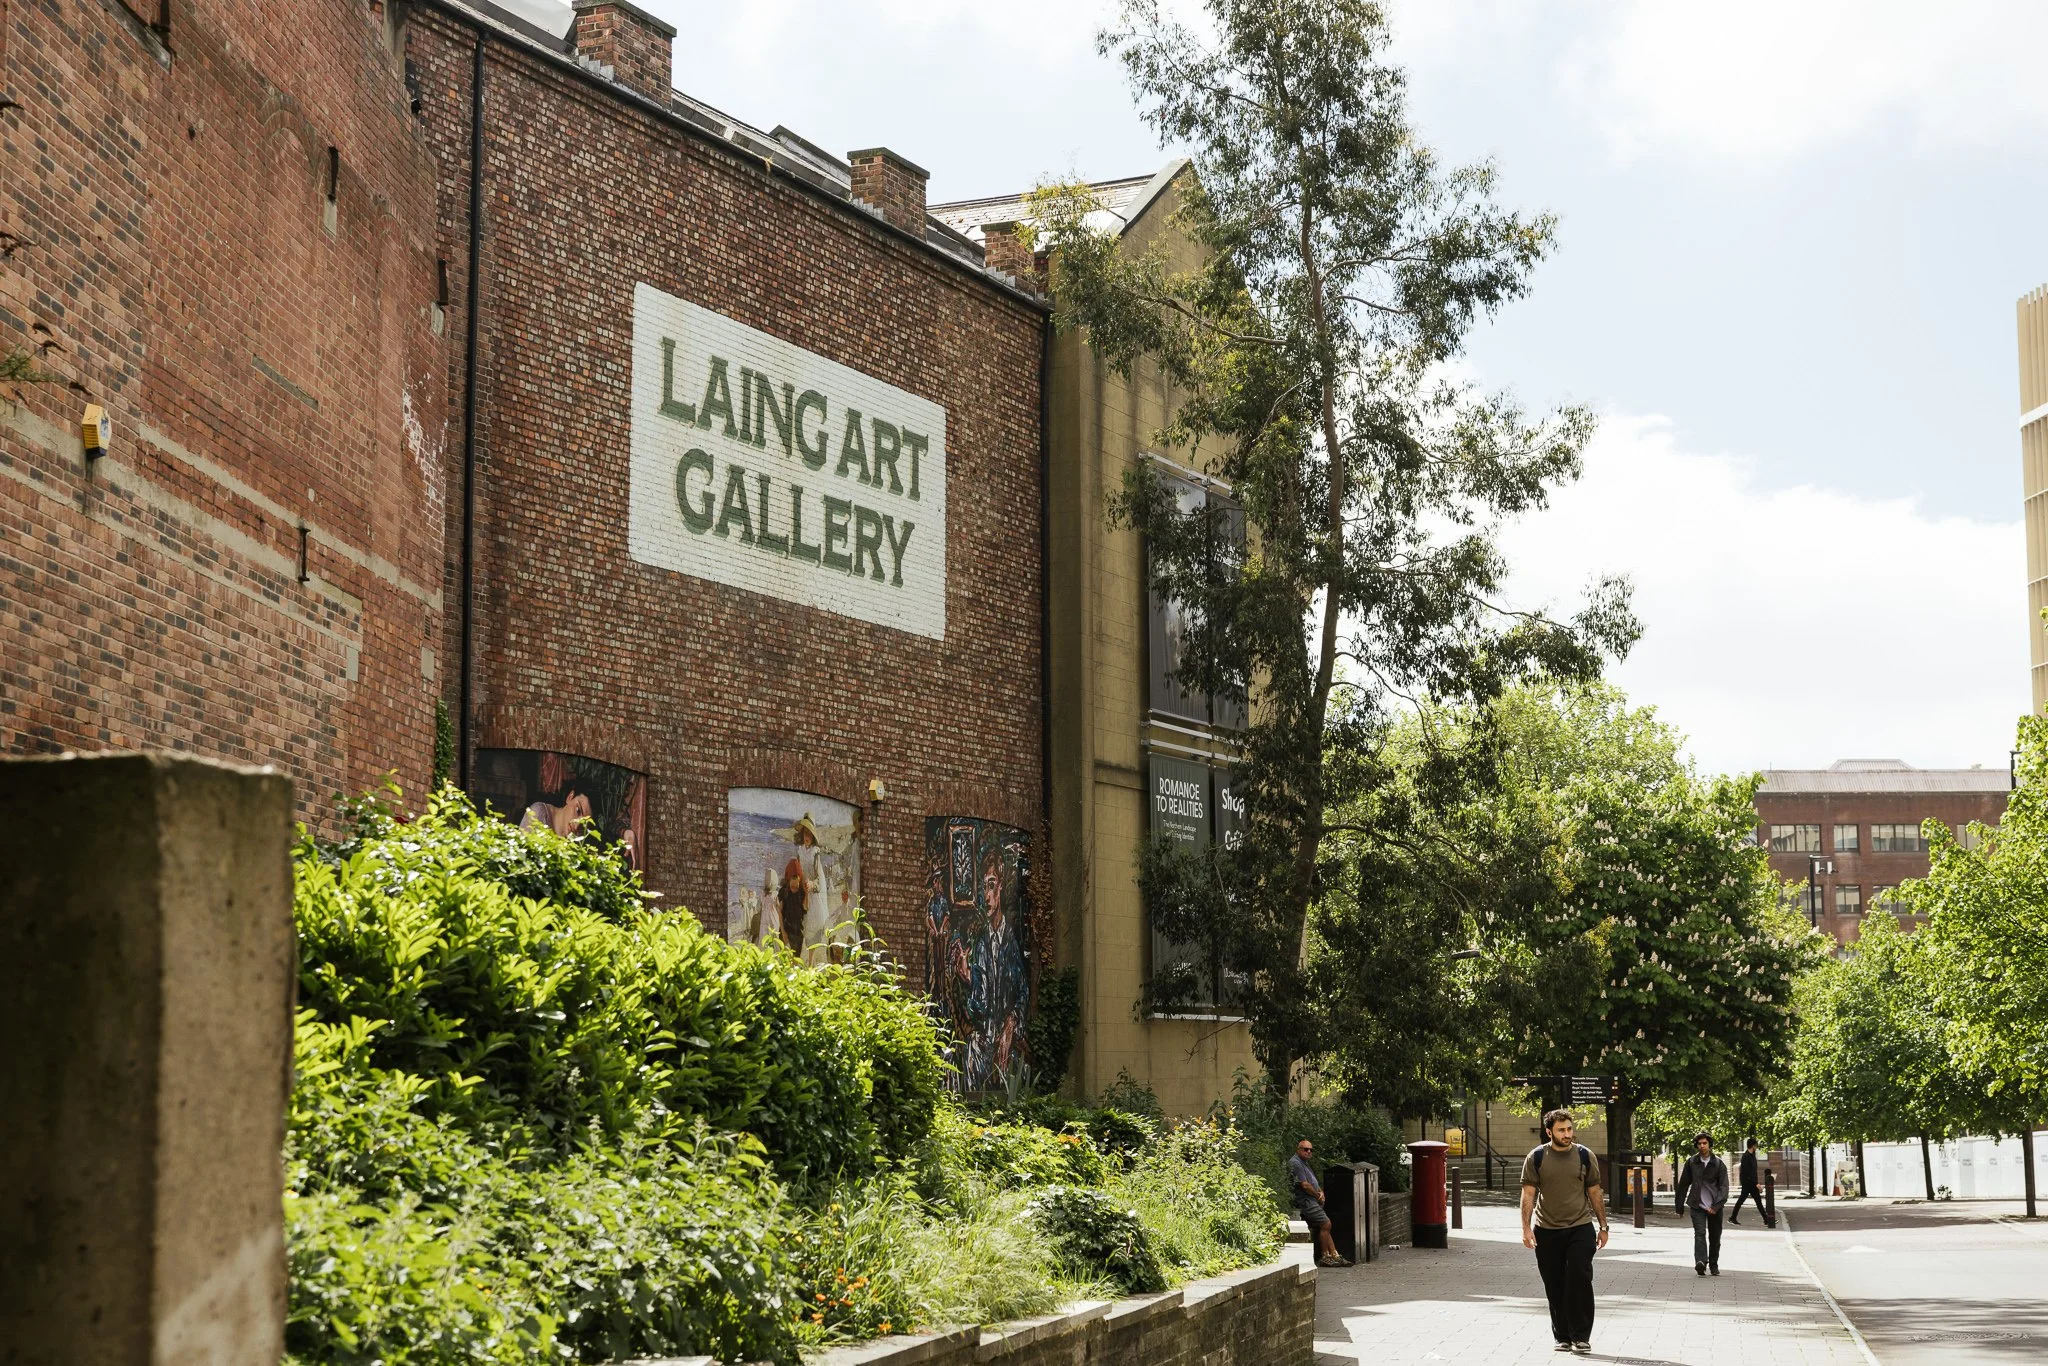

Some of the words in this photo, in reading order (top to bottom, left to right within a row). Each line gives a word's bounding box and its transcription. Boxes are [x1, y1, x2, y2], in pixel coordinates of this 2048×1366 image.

[658, 336, 829, 471] LAING
[834, 407, 929, 502] ART
[676, 448, 915, 588] GALLERY
[1160, 777, 1200, 800] ROMANCE
[1222, 788, 1245, 819] Shop
[1156, 795, 1167, 812] TO
[1169, 797, 1203, 819] REALITIES
